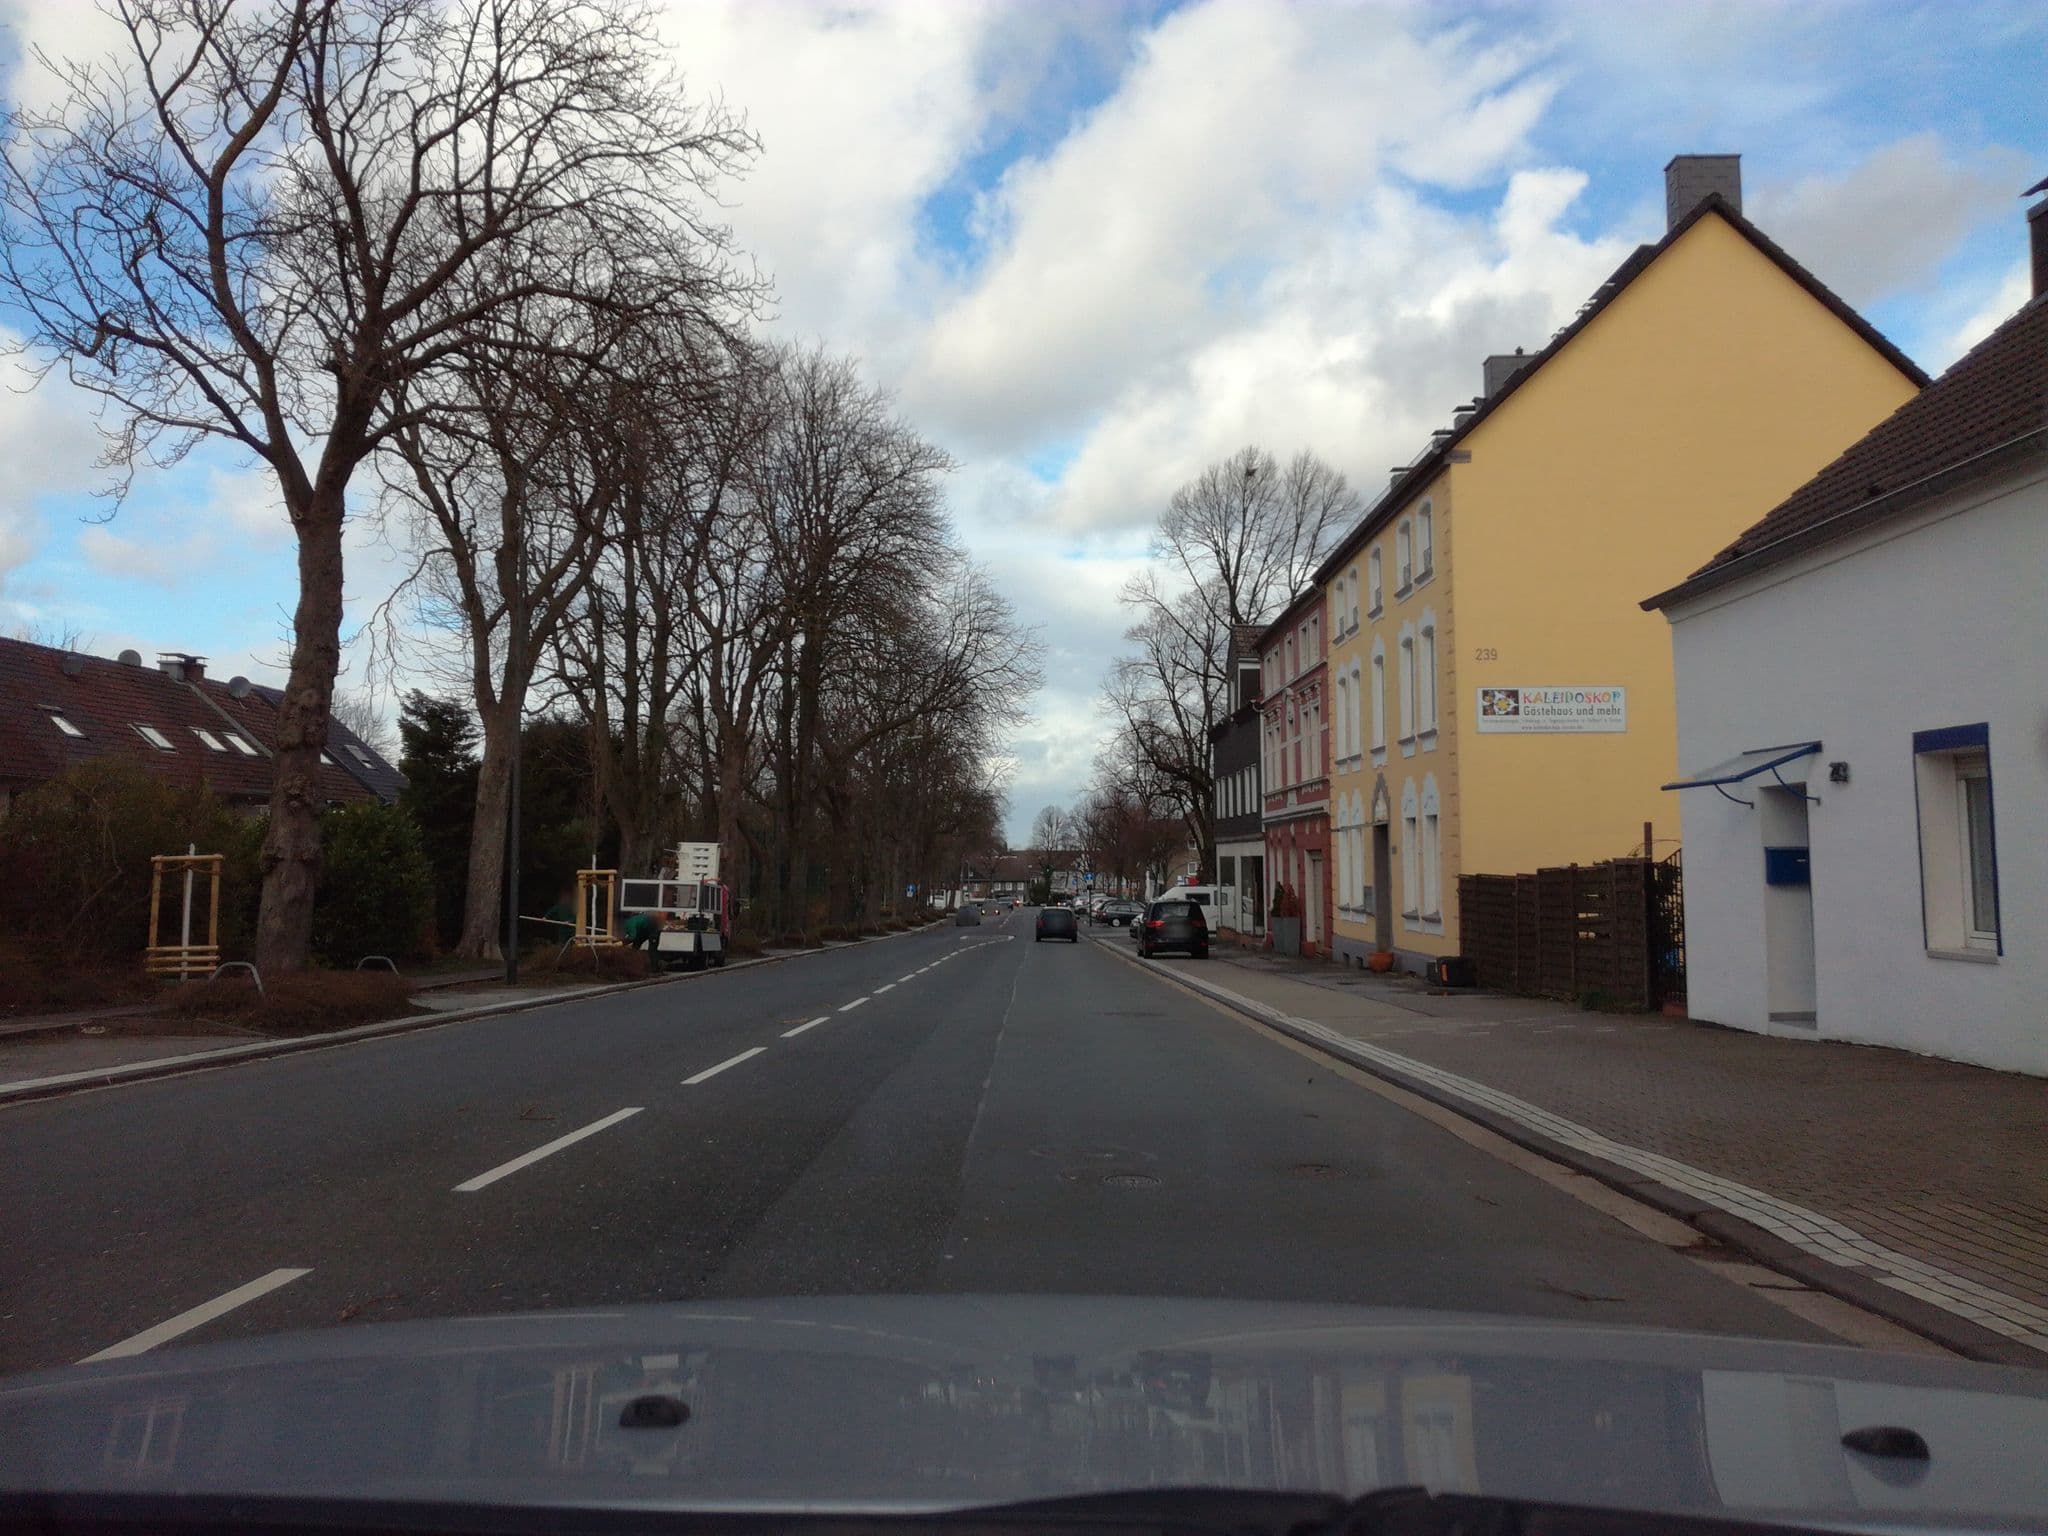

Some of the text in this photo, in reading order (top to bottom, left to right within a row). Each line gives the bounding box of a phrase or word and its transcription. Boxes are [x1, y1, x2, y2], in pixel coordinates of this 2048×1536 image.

[1475, 648, 1498, 661] 239
[1523, 691, 1621, 704] KALEIDOSKOP
[1523, 704, 1621, 717] Gästehaus und mehr
